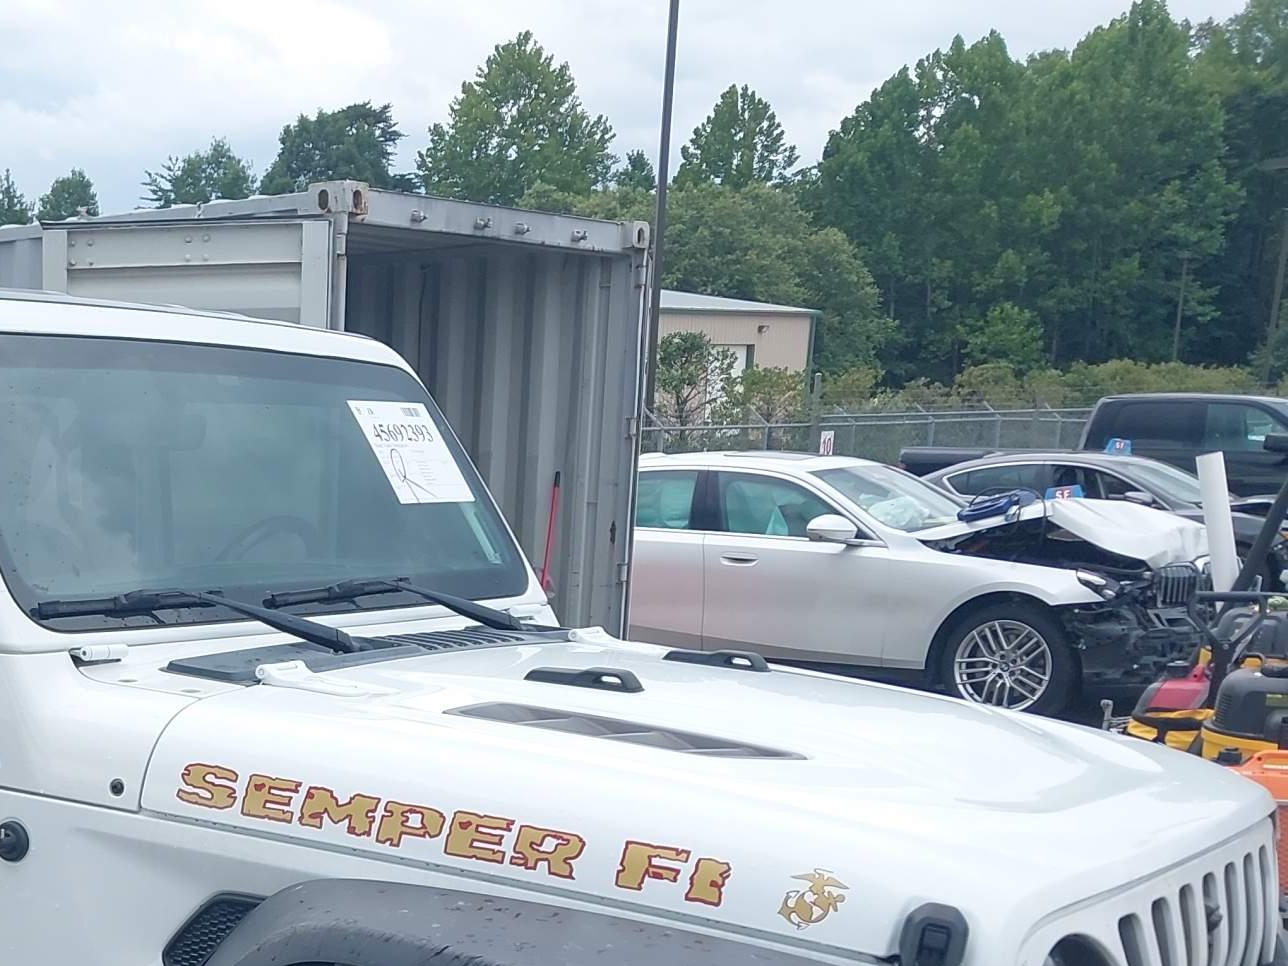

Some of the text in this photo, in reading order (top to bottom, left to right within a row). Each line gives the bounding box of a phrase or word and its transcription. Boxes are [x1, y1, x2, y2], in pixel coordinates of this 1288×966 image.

[373, 423, 434, 442] 45692393
[175, 762, 732, 908] SEMPER FI
